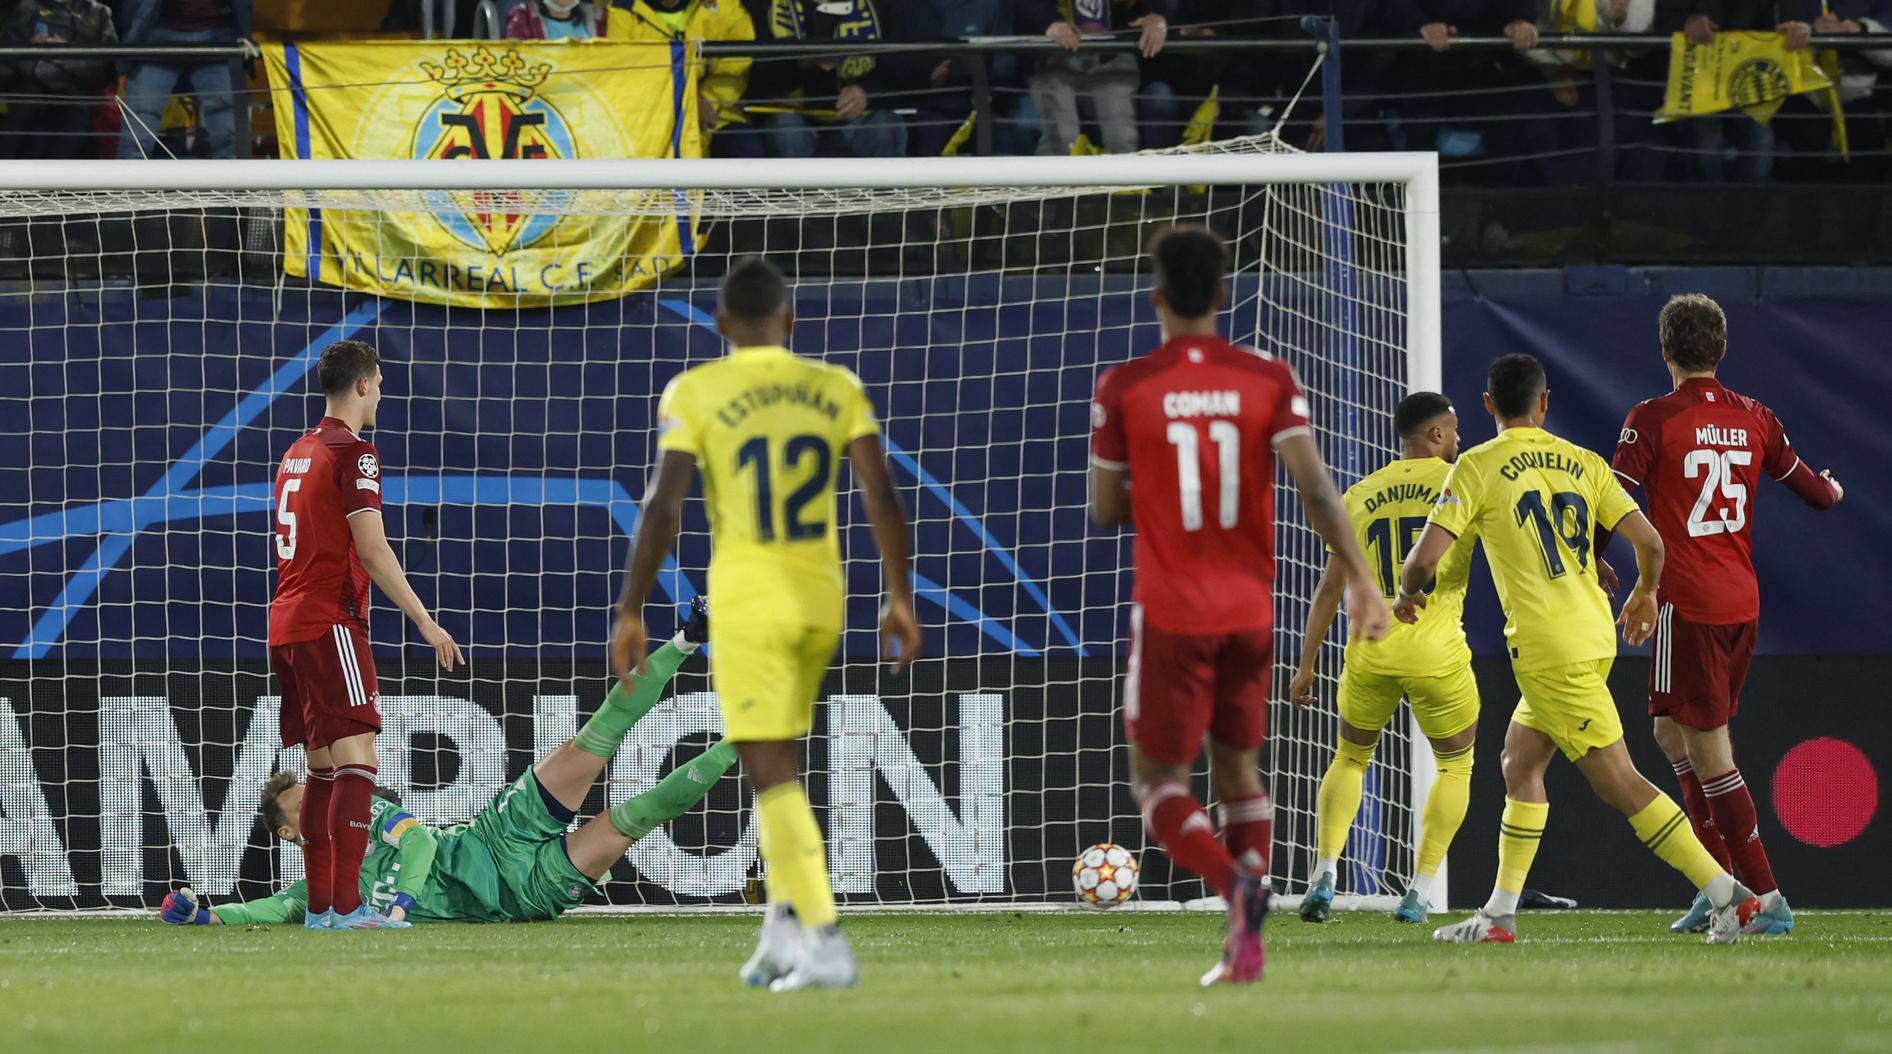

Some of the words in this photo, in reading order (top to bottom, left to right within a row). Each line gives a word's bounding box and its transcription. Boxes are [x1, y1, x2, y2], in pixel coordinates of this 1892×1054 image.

[1677, 42, 1698, 112] NDAVANT
[1163, 390, 1241, 418] COMAN
[1695, 424, 1748, 447] MÜLLER
[735, 434, 831, 543] 12
[1166, 420, 1241, 532] 11
[1500, 451, 1584, 482] COQUELIN
[1683, 449, 1752, 537] 25
[275, 478, 302, 560] 5
[1514, 489, 1591, 580] 19
